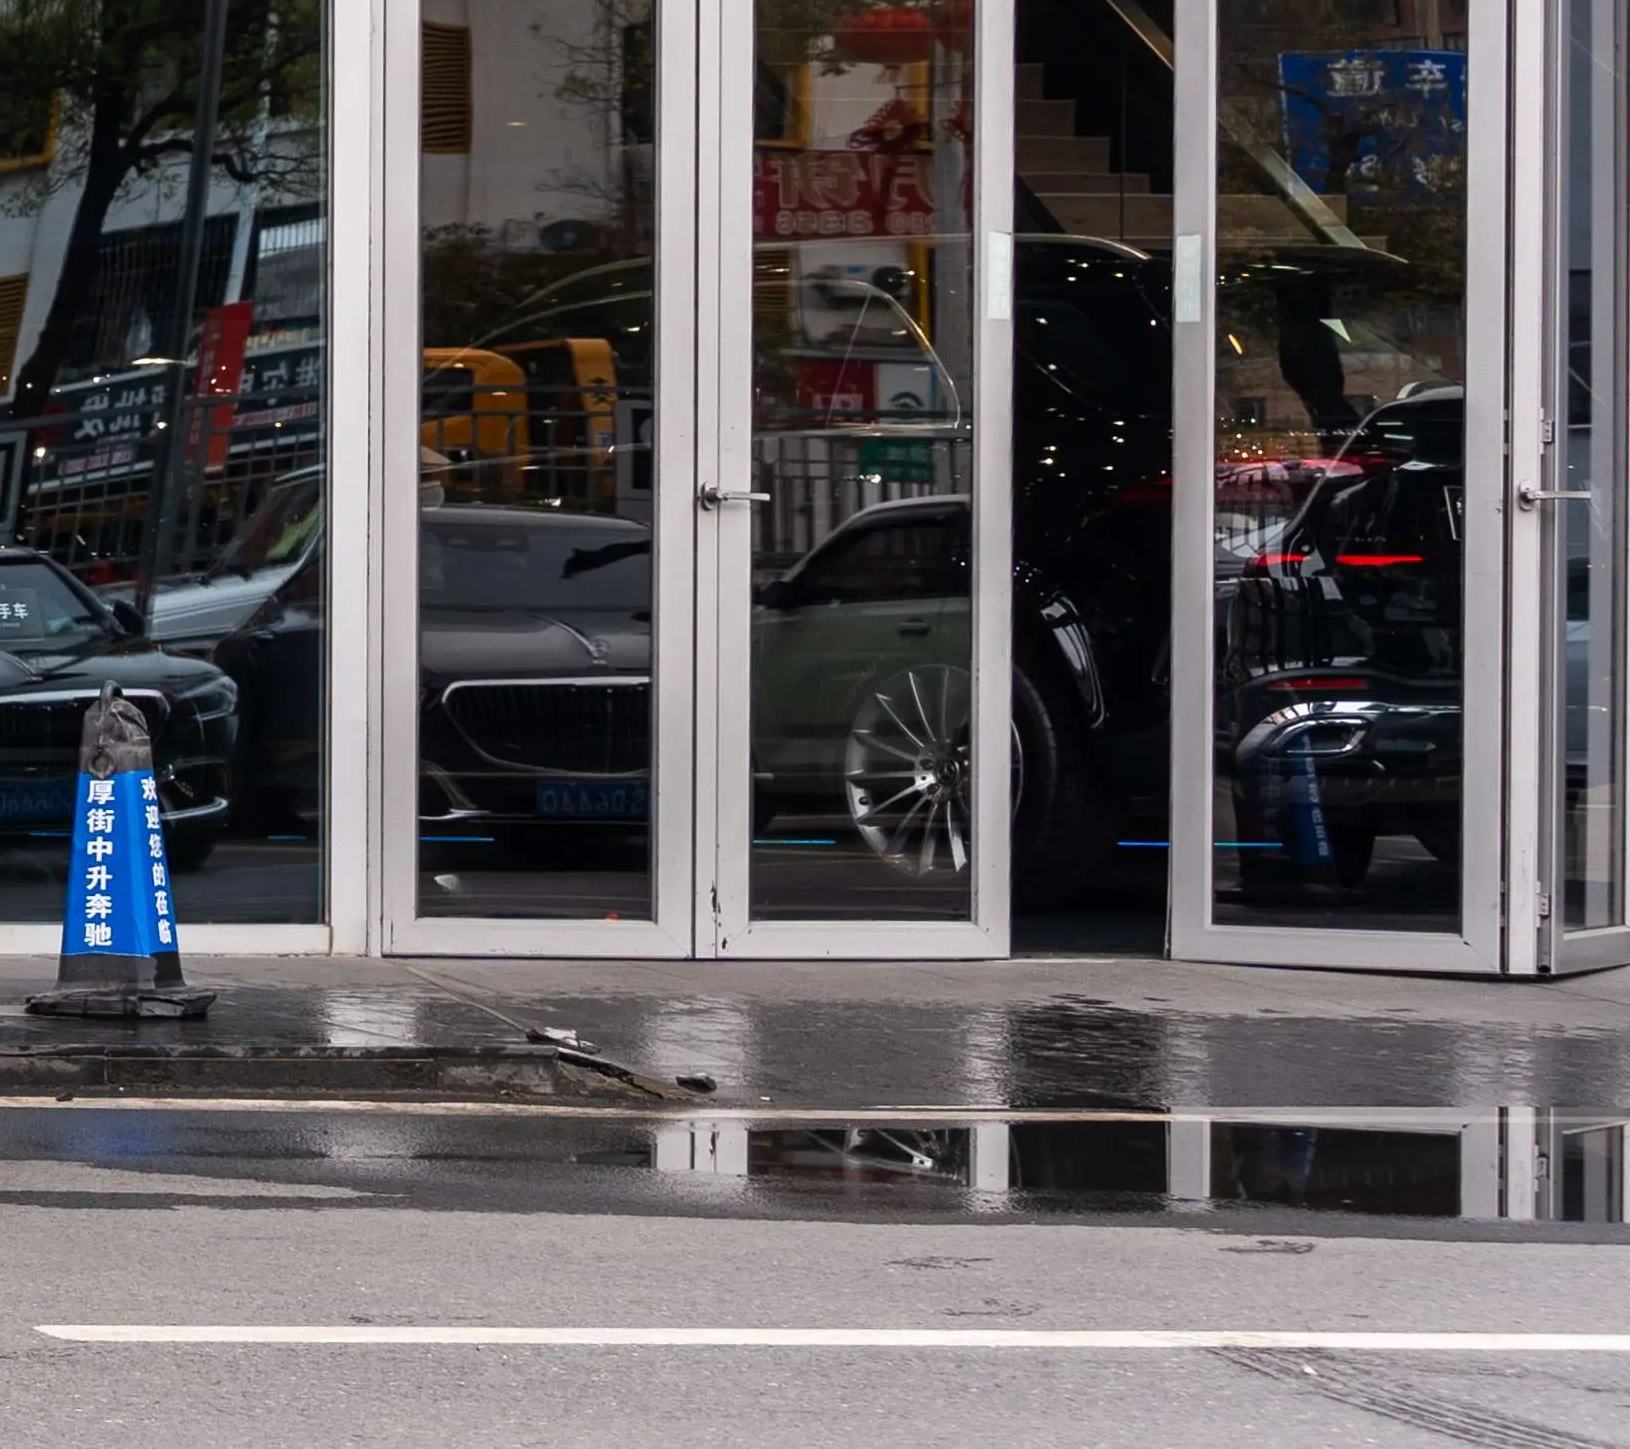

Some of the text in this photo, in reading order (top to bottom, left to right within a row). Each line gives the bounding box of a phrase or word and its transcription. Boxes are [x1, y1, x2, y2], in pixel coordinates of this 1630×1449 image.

[84, 779, 115, 947] 厚街中升奔驰
